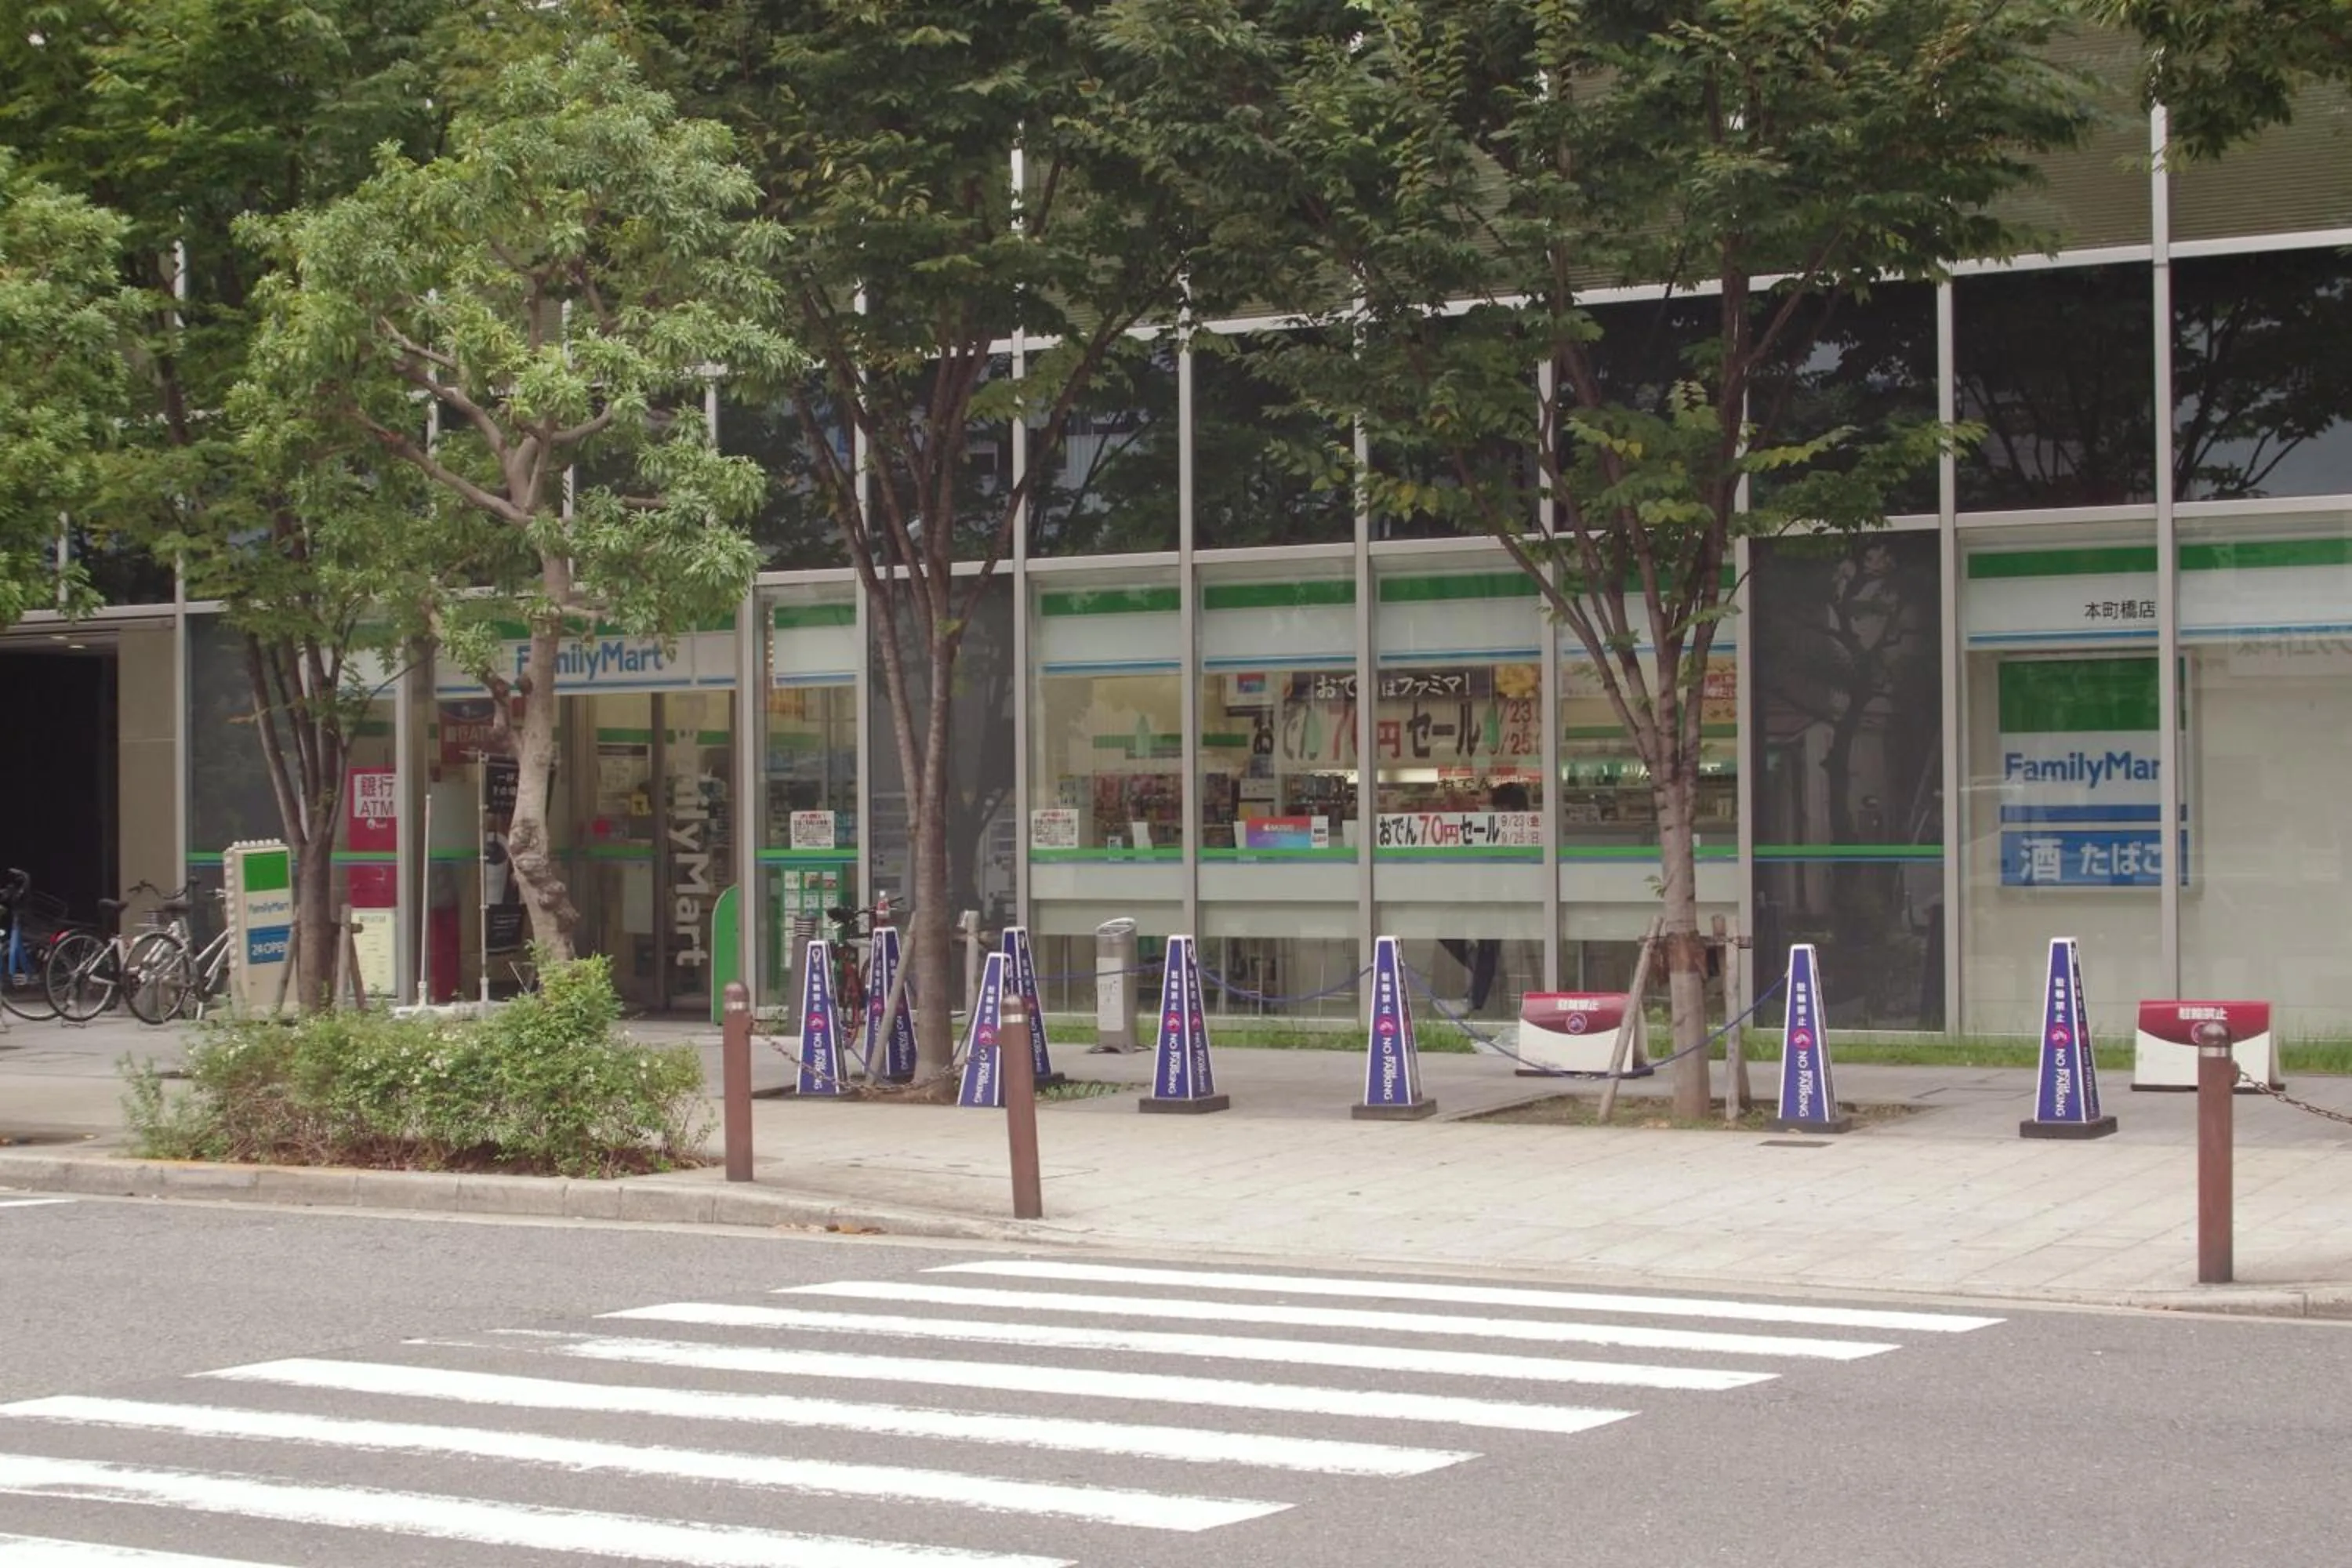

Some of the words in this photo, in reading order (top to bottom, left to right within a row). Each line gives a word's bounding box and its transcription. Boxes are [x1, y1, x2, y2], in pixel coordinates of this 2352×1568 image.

[2085, 601, 2156, 619] 本町橋店
[517, 641, 664, 681] FmilyMart
[2004, 751, 2161, 788] FamilyMar
[361, 775, 395, 797] 銀行
[361, 800, 395, 816] ATM
[1379, 815, 1500, 846] おでん70円セール
[2020, 837, 2063, 881] 酒
[2080, 842, 2161, 876] たばこ
[1169, 1033, 1178, 1048] NO
[1382, 1038, 1392, 1054] NO
[1798, 1051, 1808, 1069] NO
[2056, 1048, 2066, 1067] NO
[1383, 1057, 1393, 1101] PARKING
[2056, 1069, 2067, 1117] PARKING
